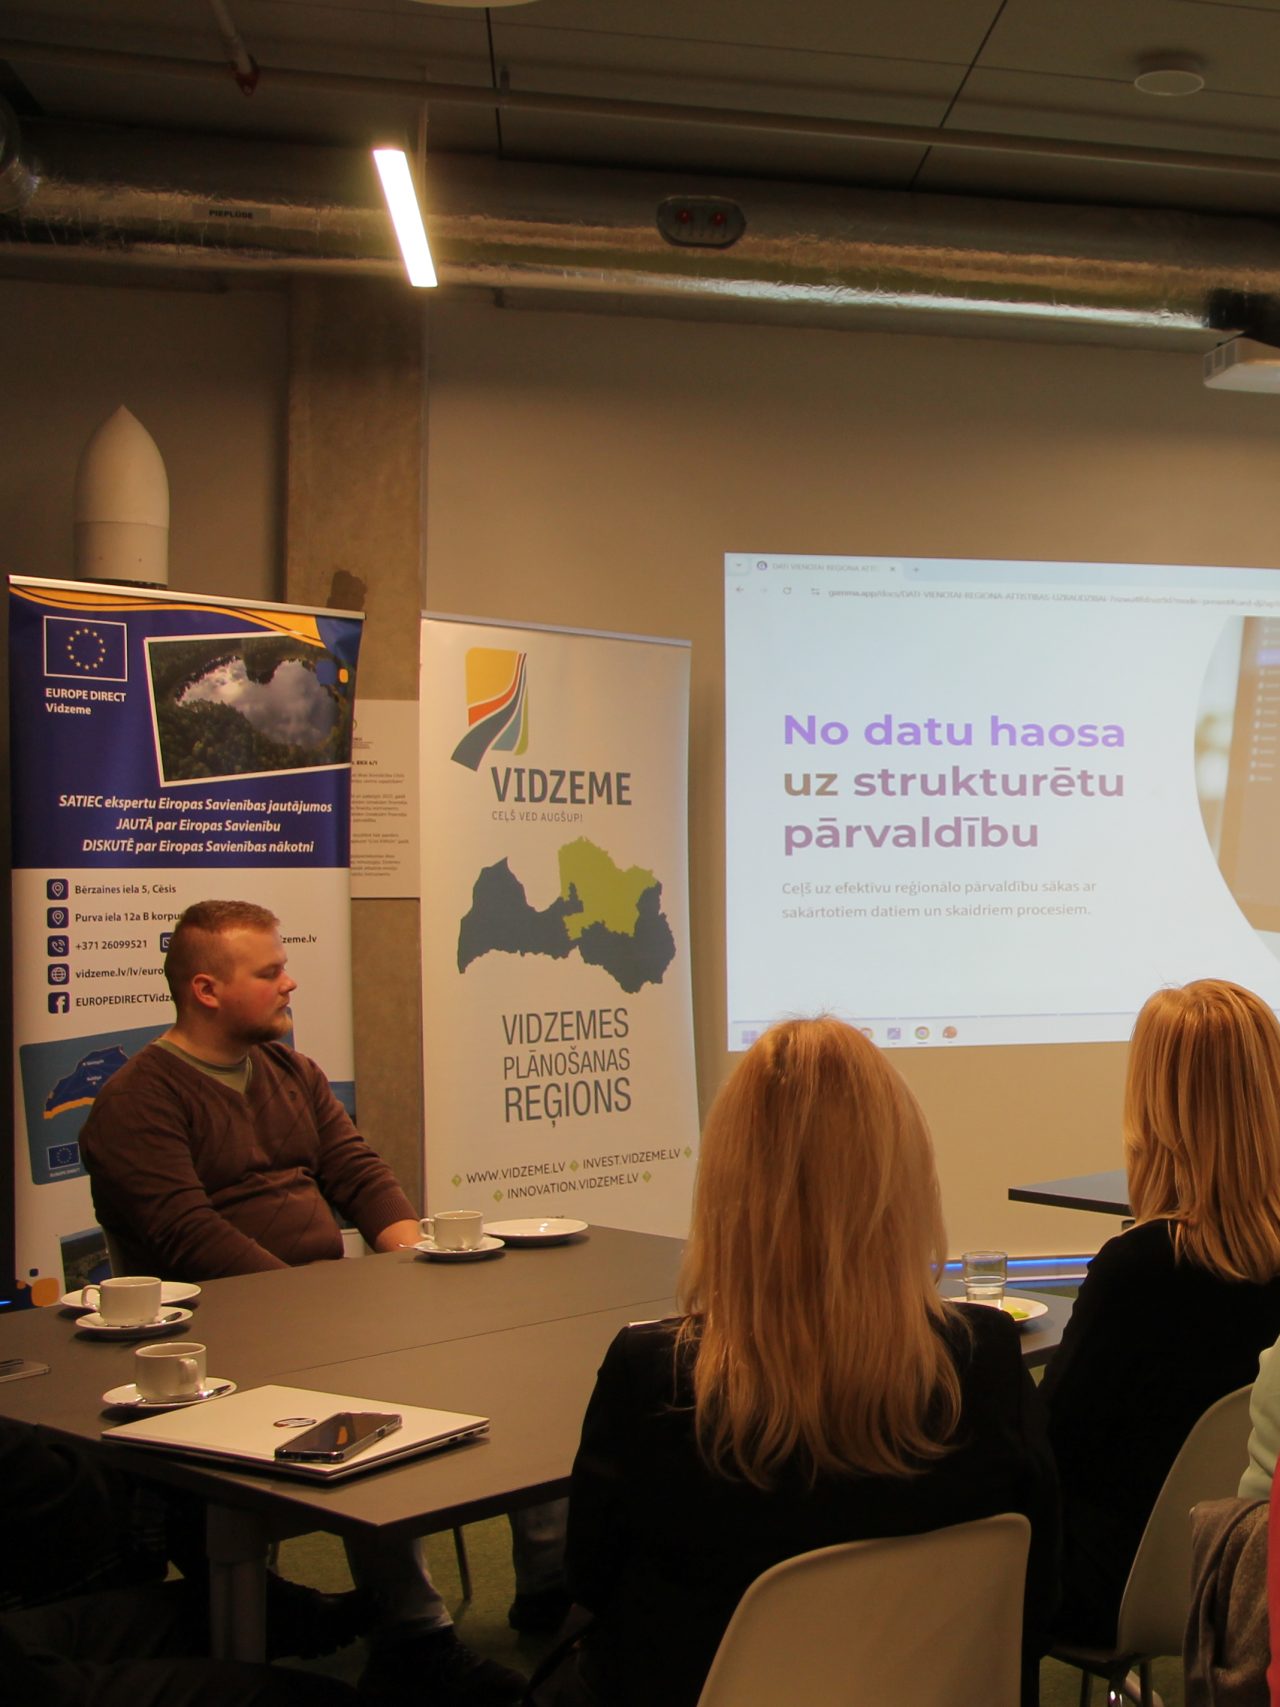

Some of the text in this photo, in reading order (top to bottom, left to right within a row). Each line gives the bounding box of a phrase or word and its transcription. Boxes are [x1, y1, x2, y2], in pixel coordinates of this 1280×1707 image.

[45, 688, 126, 702] EUROPE DIRECT
[45, 703, 92, 715] Vidzeme
[784, 714, 1125, 747] No datu haosa
[490, 766, 632, 806] VIDZEME
[784, 765, 1125, 797] uz strukturētu
[59, 795, 332, 814] SATIEC ekspertu Eiropas Savienības jautājumos
[519, 812, 538, 821] VED
[116, 817, 281, 834] JAUTĀ par Eiropas Savienību
[784, 817, 1038, 856] pārvaldību
[82, 838, 314, 855] DISKUTĒ par Eiropas Savienības nākotni
[122, 885, 140, 894] iela
[141, 885, 150, 895] 5,
[815, 884, 831, 894] uz
[1082, 883, 1097, 892] ar
[75, 911, 184, 922] Purva iela 12a B korpu
[871, 906, 920, 918] datiem
[924, 907, 942, 917] un
[945, 904, 1013, 917] skaidriem
[1017, 903, 1092, 917] procesiem.
[75, 940, 147, 951] +371 26099521
[280, 933, 317, 944] zeme.lv
[75, 967, 165, 979] vidzeme.lv/lv/euro
[502, 1007, 630, 1045] VIDZEMES
[503, 1045, 631, 1080] PLĀNOŠANAS
[504, 1077, 632, 1128] REĢIONS
[466, 1148, 681, 1184] WWW.VIDZEME.LV INVEST.VIDZEME.LV
[507, 1173, 639, 1199] INNOVATION.VIDZEME.LV
